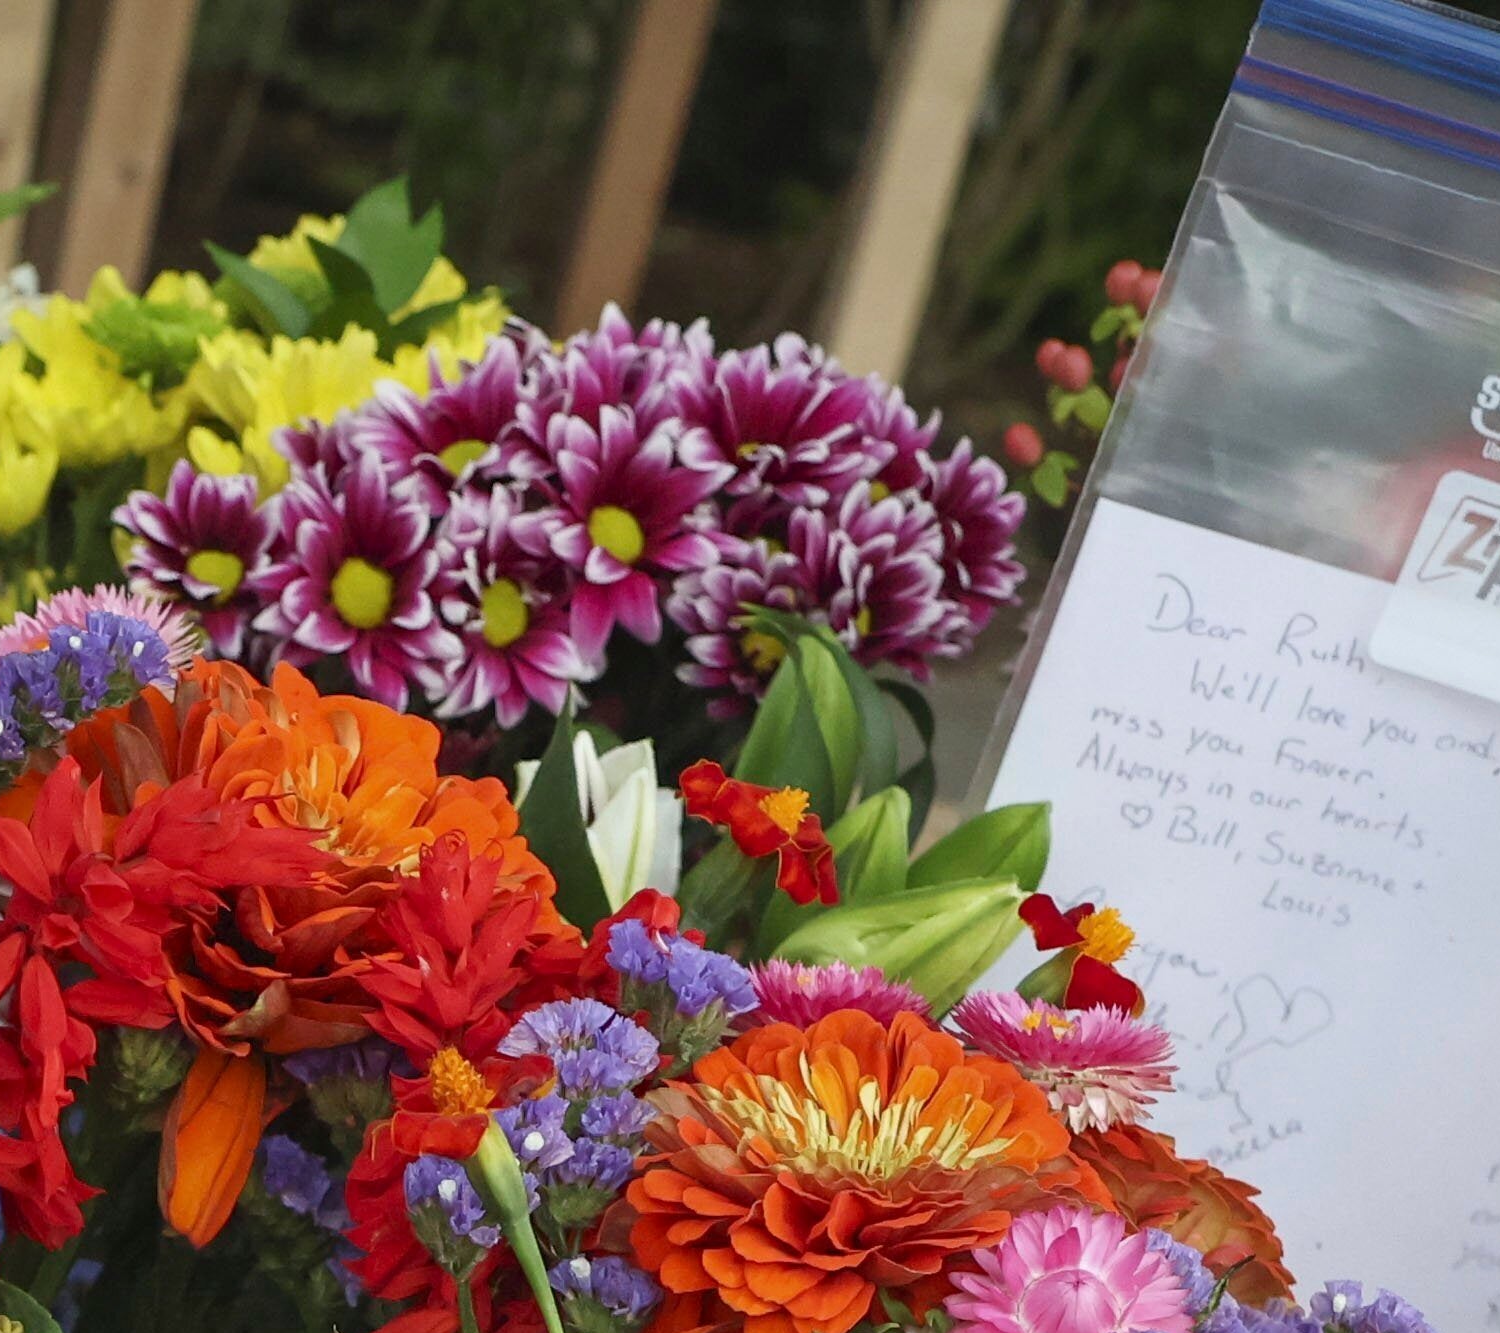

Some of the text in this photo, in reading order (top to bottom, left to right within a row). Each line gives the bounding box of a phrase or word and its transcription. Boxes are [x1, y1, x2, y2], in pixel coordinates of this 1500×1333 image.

[1145, 572, 1248, 641] Dear
[1090, 704, 1164, 741] miss
[1184, 726, 1245, 757] you
[1190, 657, 1279, 713] We'll
[1297, 685, 1348, 730] love
[1361, 716, 1418, 748] you
[1075, 730, 1189, 799] Always
[1206, 780, 1234, 800] in
[1249, 788, 1303, 810] our
[1260, 878, 1351, 928] Louis
